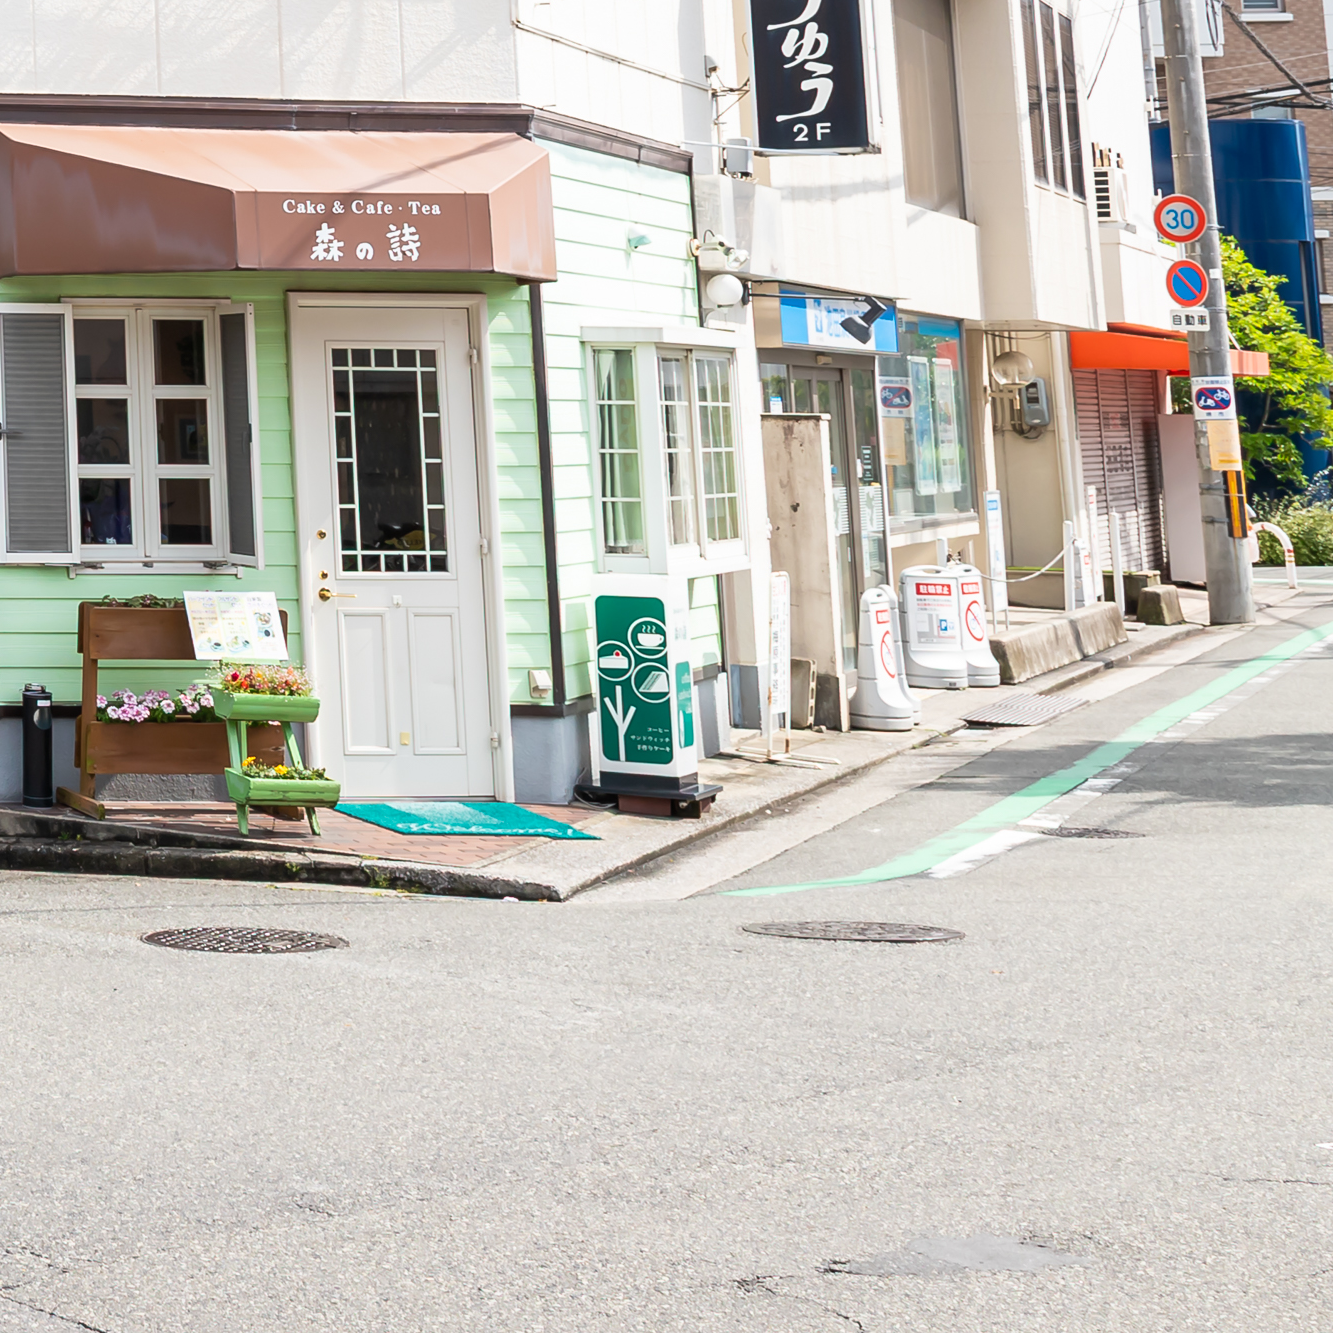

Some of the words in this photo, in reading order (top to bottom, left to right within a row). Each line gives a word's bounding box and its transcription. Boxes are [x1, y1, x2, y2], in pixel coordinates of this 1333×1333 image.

[793, 122, 832, 141] 2F
[282, 199, 326, 214] Cake
[332, 200, 345, 214] &
[351, 200, 393, 215] Cafe
[408, 201, 442, 215] Tea
[1165, 208, 1195, 230] 30
[310, 222, 421, 262] 森の詩
[1172, 314, 1208, 326] 自動車
